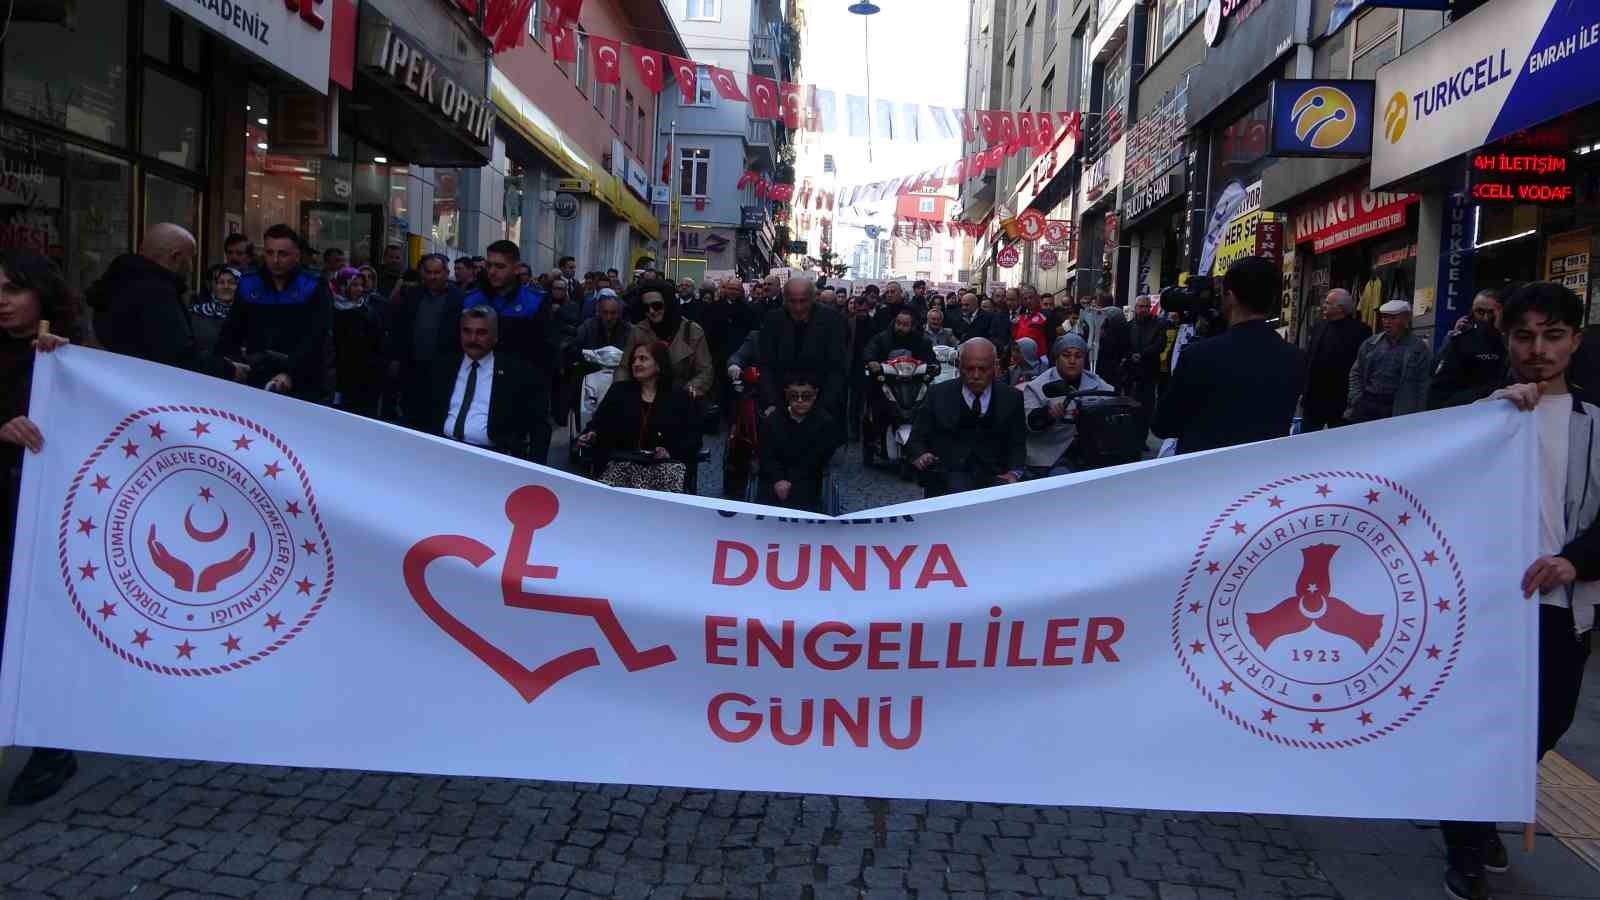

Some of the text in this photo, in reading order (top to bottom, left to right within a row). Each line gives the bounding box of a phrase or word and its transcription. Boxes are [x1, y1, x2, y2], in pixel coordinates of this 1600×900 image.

[1529, 34, 1577, 74] EMRAH
[1413, 48, 1512, 121] TURKCELL
[1499, 153, 1566, 174] İLETİŞİM
[1447, 193, 1464, 311] TURKCELL
[199, 453, 248, 490] SOSYAL
[111, 466, 158, 567] CUMHURİYETİ
[247, 487, 290, 563] HİZMETLER
[119, 569, 169, 620] TÜRKİYE
[211, 565, 286, 624] BAKANLIĞI
[712, 539, 968, 592] DÜNYA
[1216, 511, 1417, 700] TÜRKİYE CUMHURİYETİ GİRESUN VALİLİĞİ
[704, 606, 1126, 671] ENGELLİLER
[1291, 648, 1342, 663] 1923
[706, 692, 925, 750] GÜNÜ
